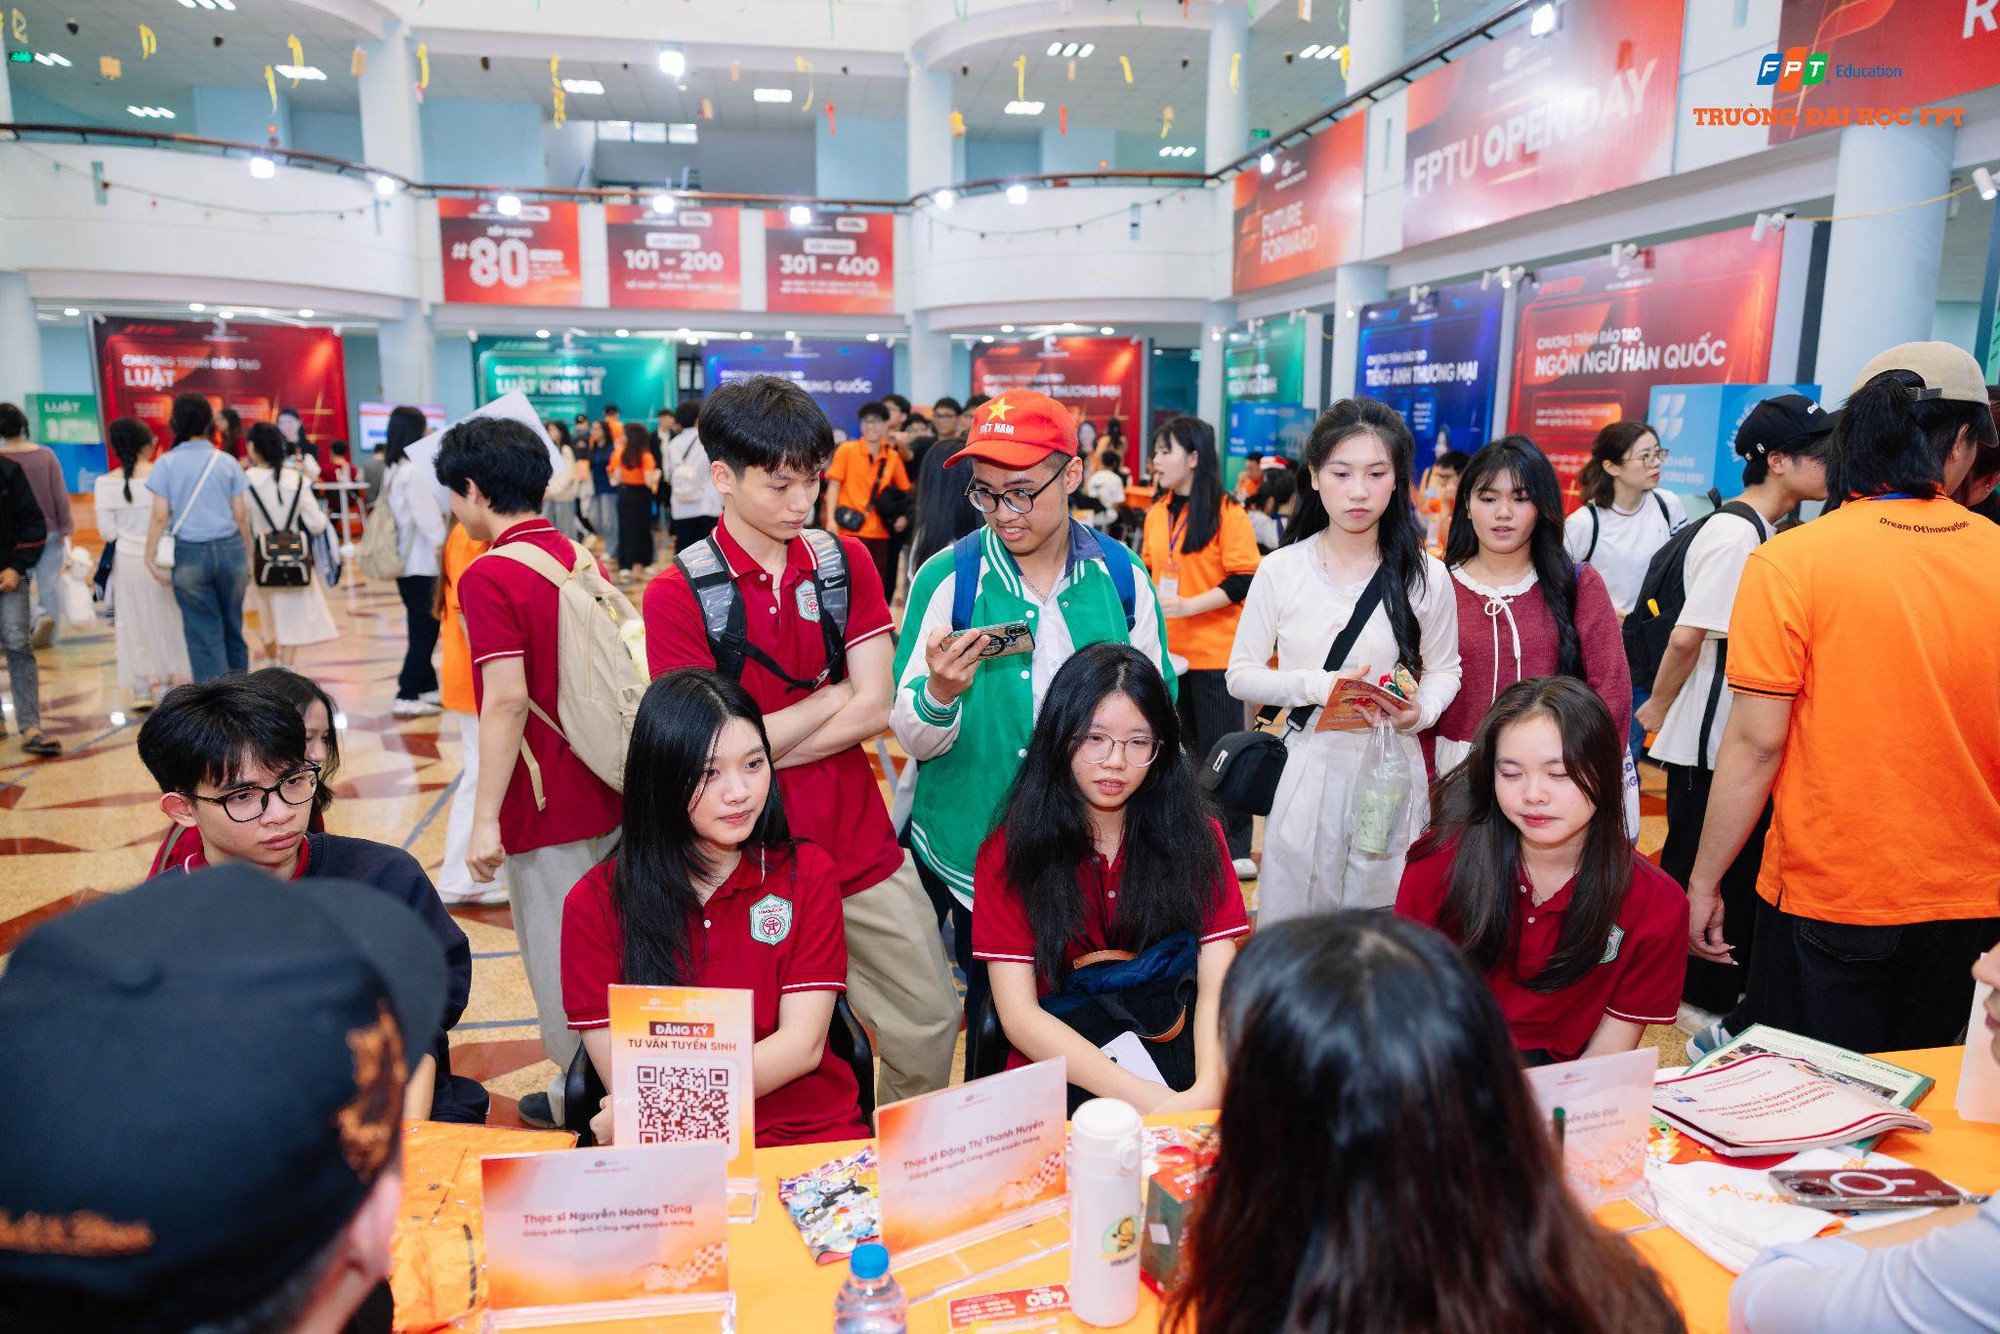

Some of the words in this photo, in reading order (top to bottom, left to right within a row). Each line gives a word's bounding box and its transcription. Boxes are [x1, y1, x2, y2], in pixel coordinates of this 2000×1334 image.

[1412, 134, 1480, 198] FPTU
[1483, 95, 1568, 169] OPEN
[1574, 58, 1658, 136] DAY
[623, 249, 660, 270] 101
[680, 251, 724, 272] 200
[779, 254, 817, 275] 301
[836, 256, 880, 277] 400
[1534, 348, 1580, 377] NGÔN
[1582, 343, 1622, 374] NGỮ
[1622, 340, 1660, 372] HÀN
[1663, 330, 1727, 369] QUỐC
[123, 365, 176, 392] LUẬT
[1413, 362, 1455, 384] THƯƠNG
[1456, 360, 1479, 386] MẠI
[994, 422, 1015, 435] NAM
[1879, 517, 1911, 531] Dream
[1913, 525, 1926, 533] Of
[1926, 520, 1969, 533] Innovation
[655, 1022, 690, 1036] ĐĂNG
[693, 1023, 709, 1036] KÝ
[628, 1039, 643, 1048] TƯ
[645, 1037, 668, 1049] VẤN
[671, 1038, 707, 1050] TUYỂN
[711, 1042, 737, 1051] SINH
[903, 1157, 927, 1171] Thạc
[969, 1138, 983, 1149] Thị
[985, 1129, 1014, 1144] Thanh
[522, 1214, 552, 1225] Thạc
[569, 1208, 616, 1223] Nguyễn
[619, 1206, 660, 1218] Hoàng
[662, 1203, 693, 1215] Tùng
